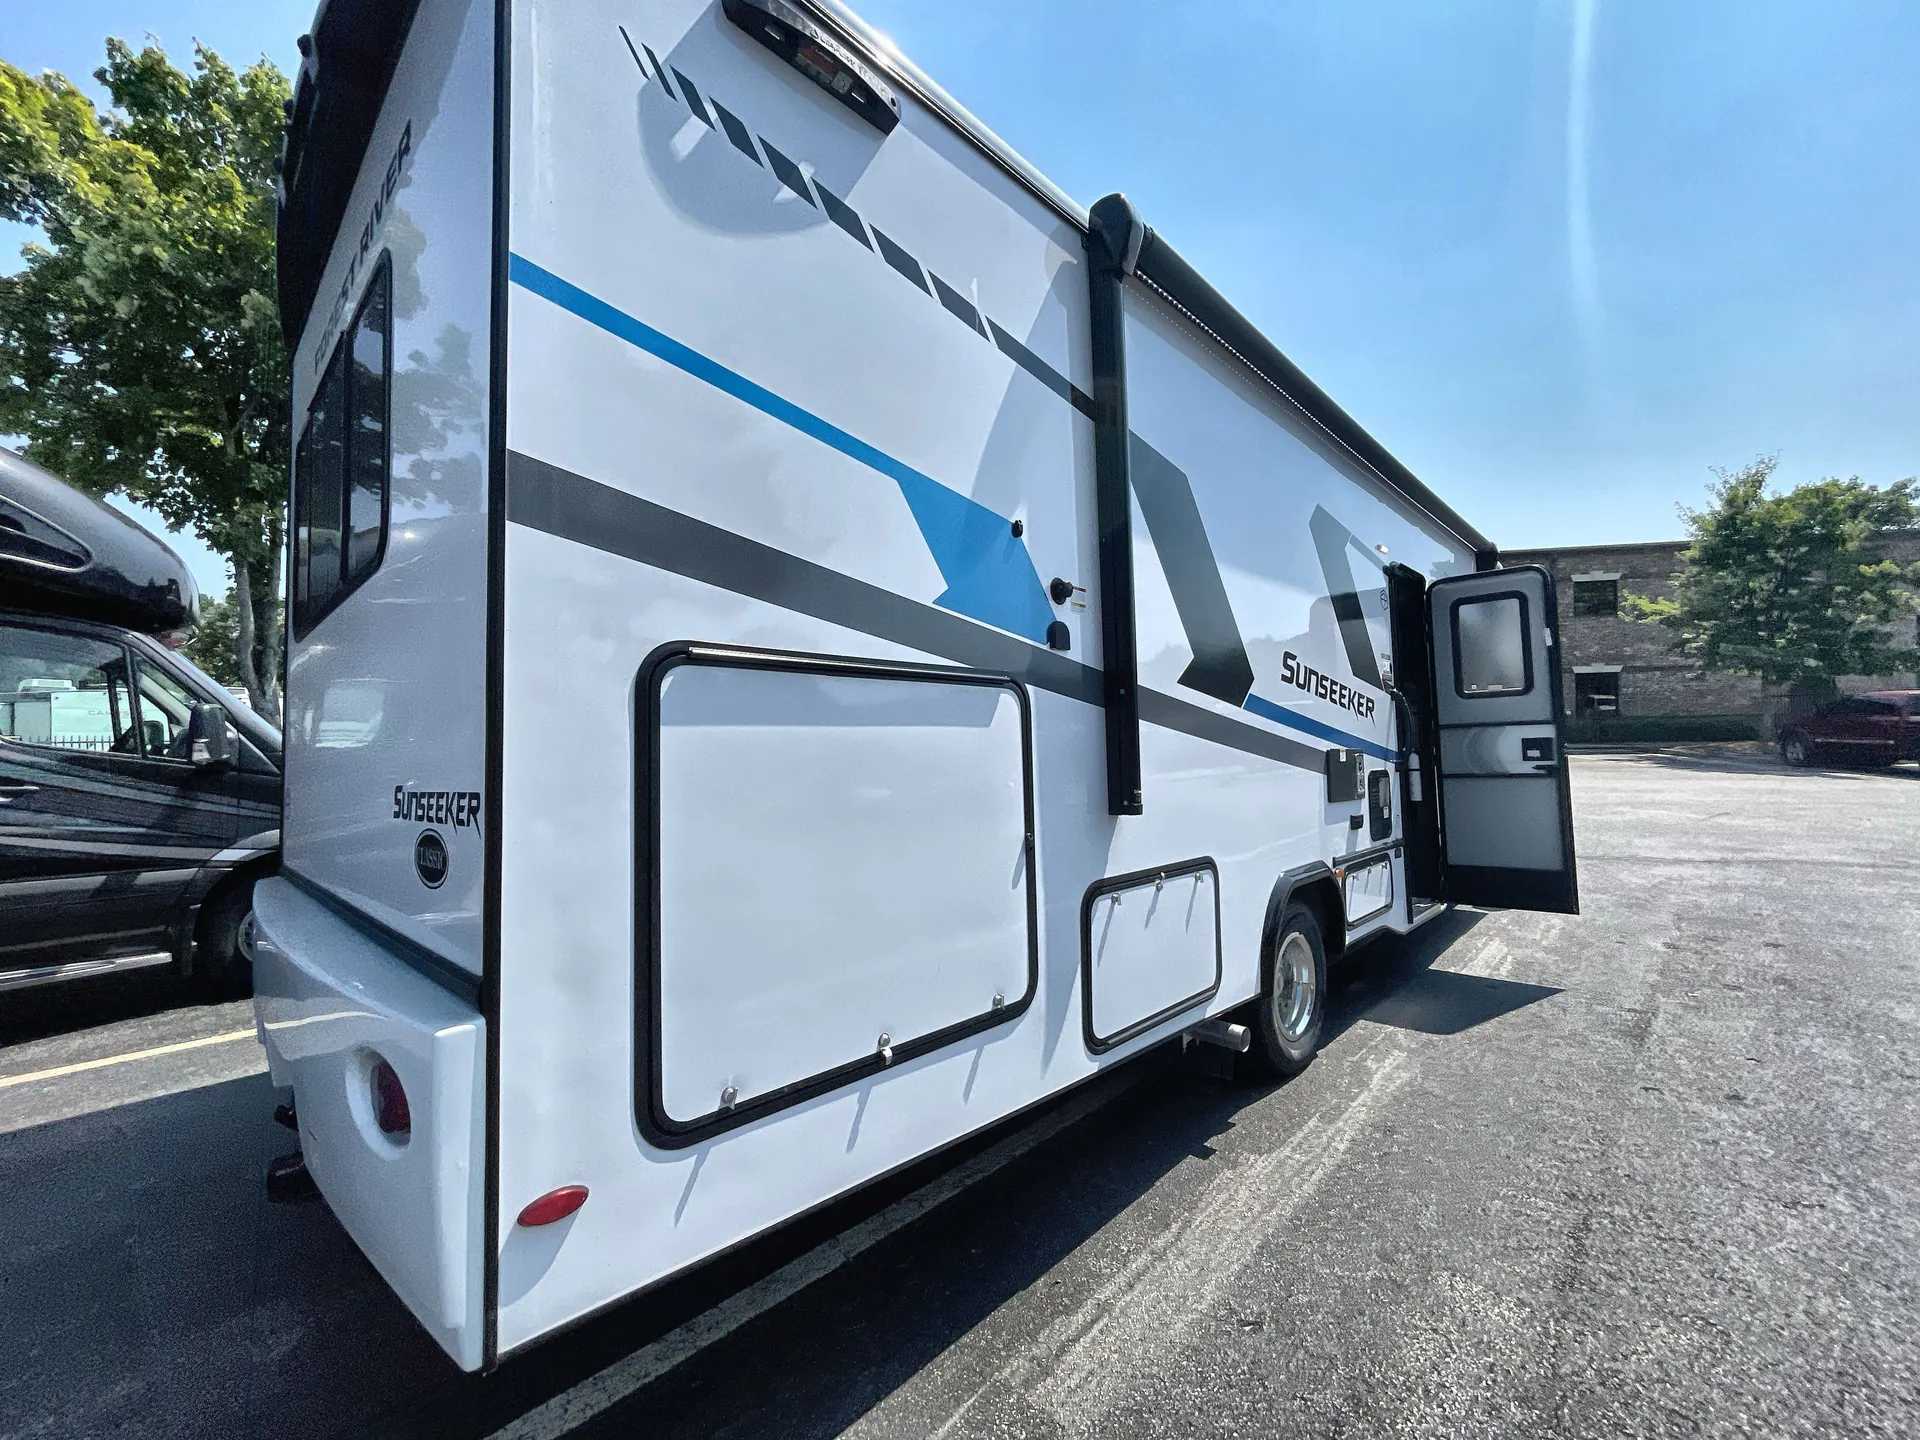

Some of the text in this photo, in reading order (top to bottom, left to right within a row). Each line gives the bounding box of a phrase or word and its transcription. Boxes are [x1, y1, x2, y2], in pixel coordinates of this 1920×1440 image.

[360, 118, 411, 267] RIVER
[1280, 650, 1376, 728] SUNSEEKER
[393, 785, 482, 840] SUNSEEKER
